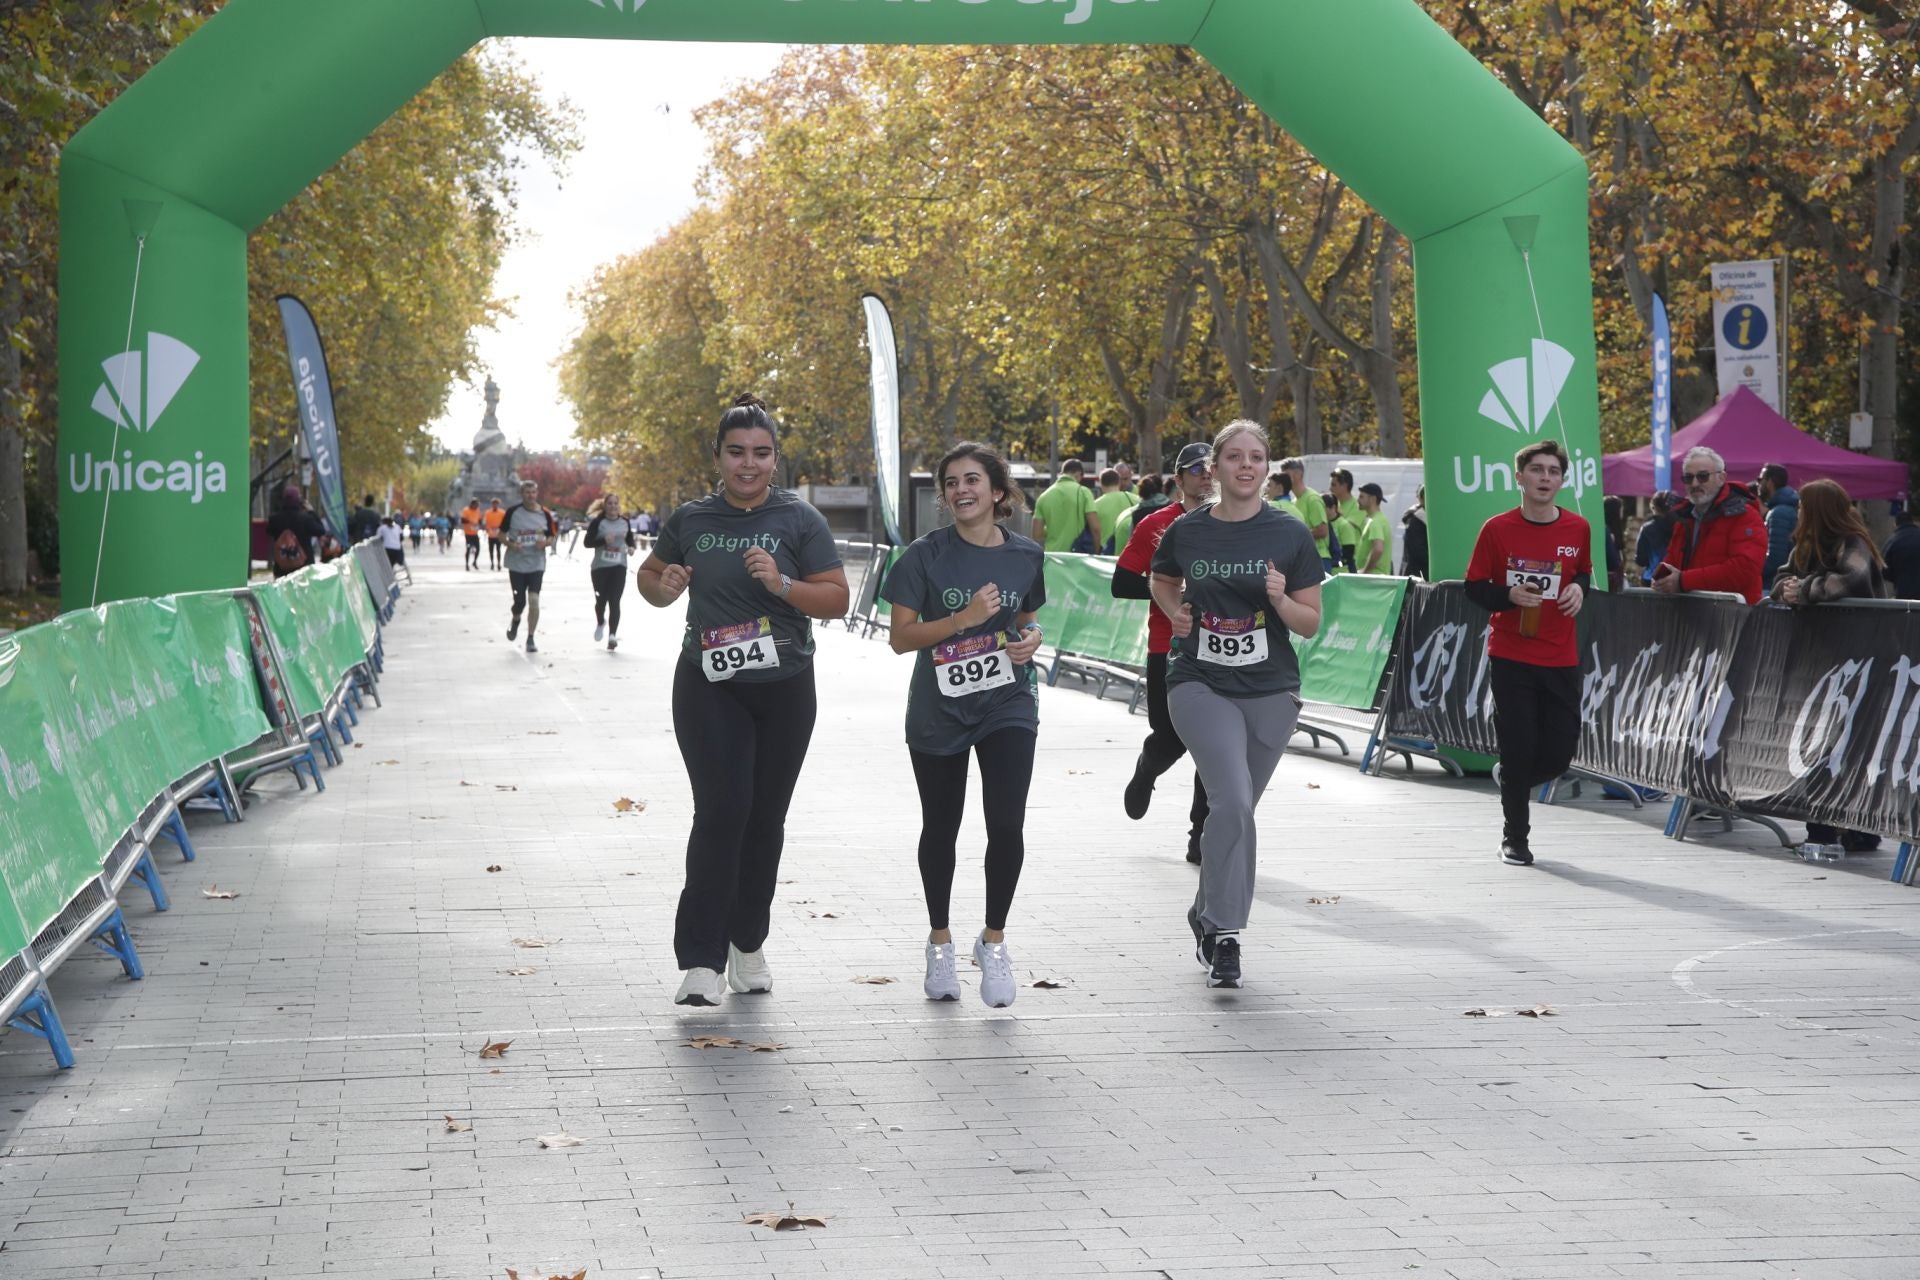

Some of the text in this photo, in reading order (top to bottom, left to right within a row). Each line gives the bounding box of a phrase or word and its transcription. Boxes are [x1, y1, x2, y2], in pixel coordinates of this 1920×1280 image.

[1747, 270, 1757, 278] de
[70, 450, 226, 503] Unicaja
[1454, 448, 1597, 499] Unaja
[710, 641, 765, 672] 894
[1207, 634, 1256, 657] 893
[947, 655, 1001, 686] 892
